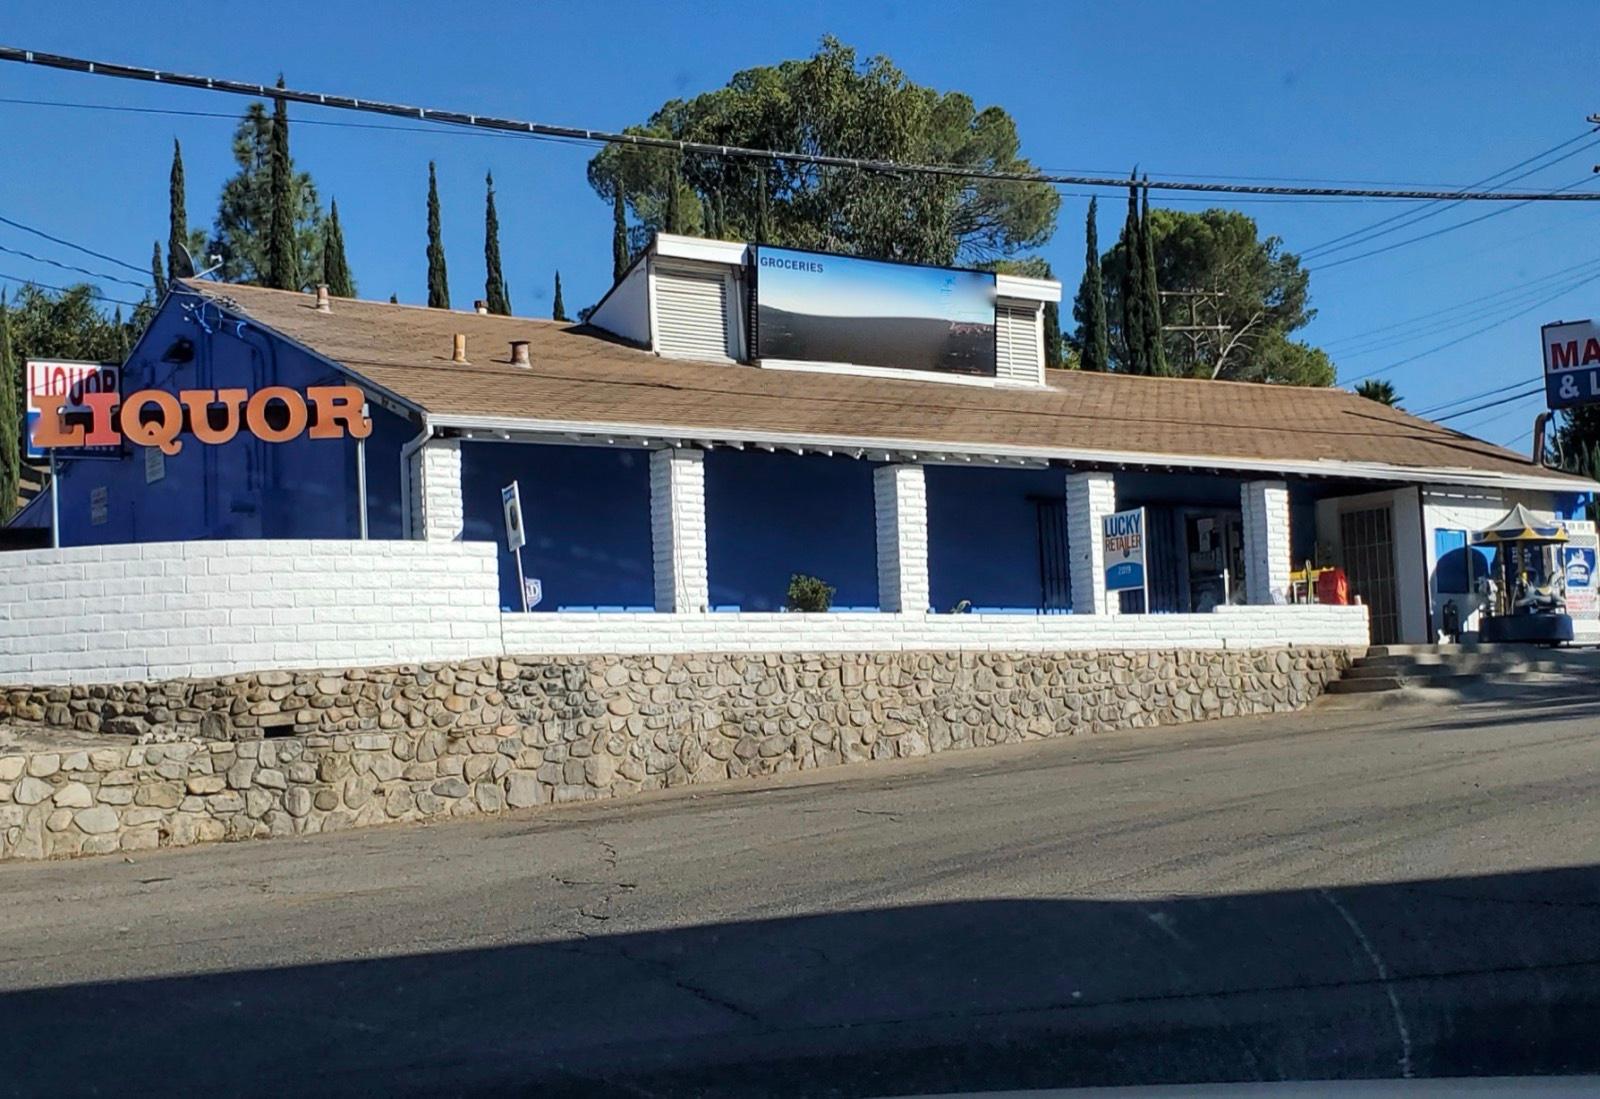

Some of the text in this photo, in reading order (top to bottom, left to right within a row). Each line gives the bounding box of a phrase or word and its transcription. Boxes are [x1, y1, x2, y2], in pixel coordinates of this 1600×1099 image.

[760, 256, 824, 273] GROCERIES
[1560, 374, 1580, 399] &
[31, 386, 372, 455] LIQUOR
[1104, 513, 1140, 537] LUCKY
[1105, 534, 1141, 552] RETAILER
